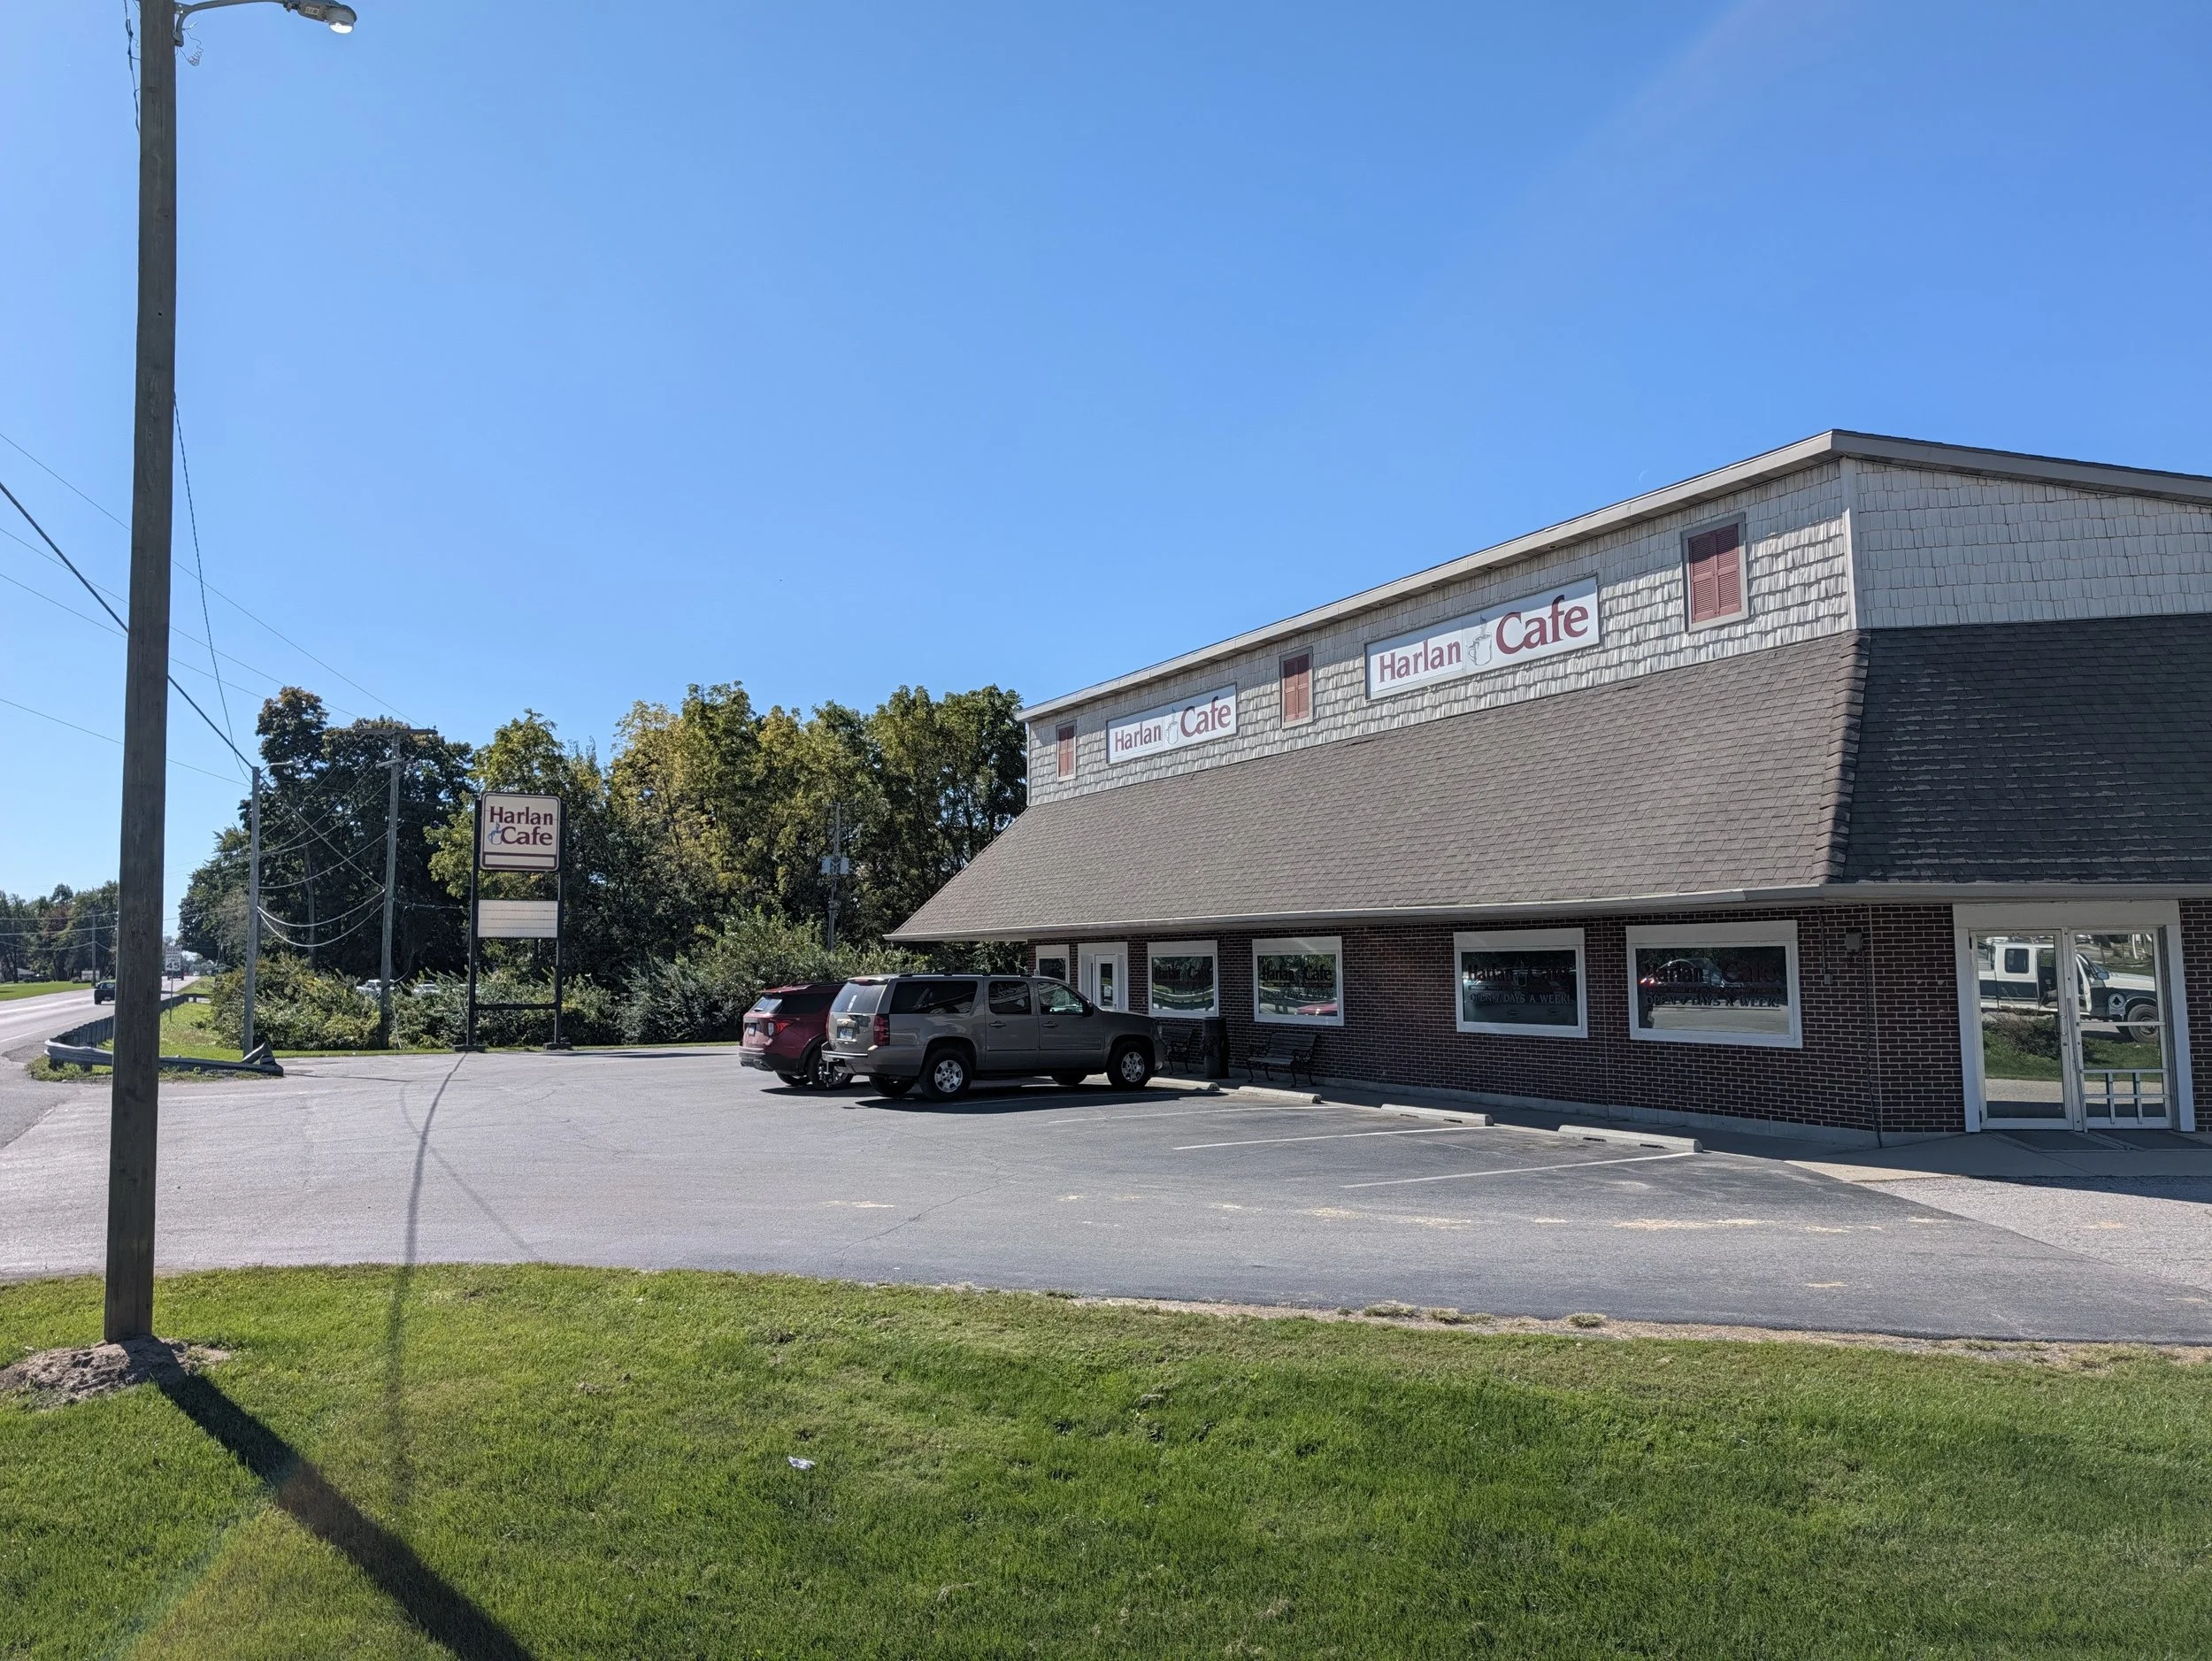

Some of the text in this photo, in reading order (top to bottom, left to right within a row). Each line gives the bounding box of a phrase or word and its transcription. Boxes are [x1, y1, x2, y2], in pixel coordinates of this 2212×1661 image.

[1378, 594, 1589, 683] Harlan Cafe
[1114, 696, 1232, 752] Harlan Cafe
[490, 806, 553, 825] Harlan
[501, 827, 553, 845] Cafe
[1262, 964, 1333, 980] Harlan Cafe
[1503, 993, 1526, 1004] DAYS
[1529, 994, 1536, 1004] A
[1691, 995, 1721, 1006] DAYS
[1725, 996, 1734, 1007] A
